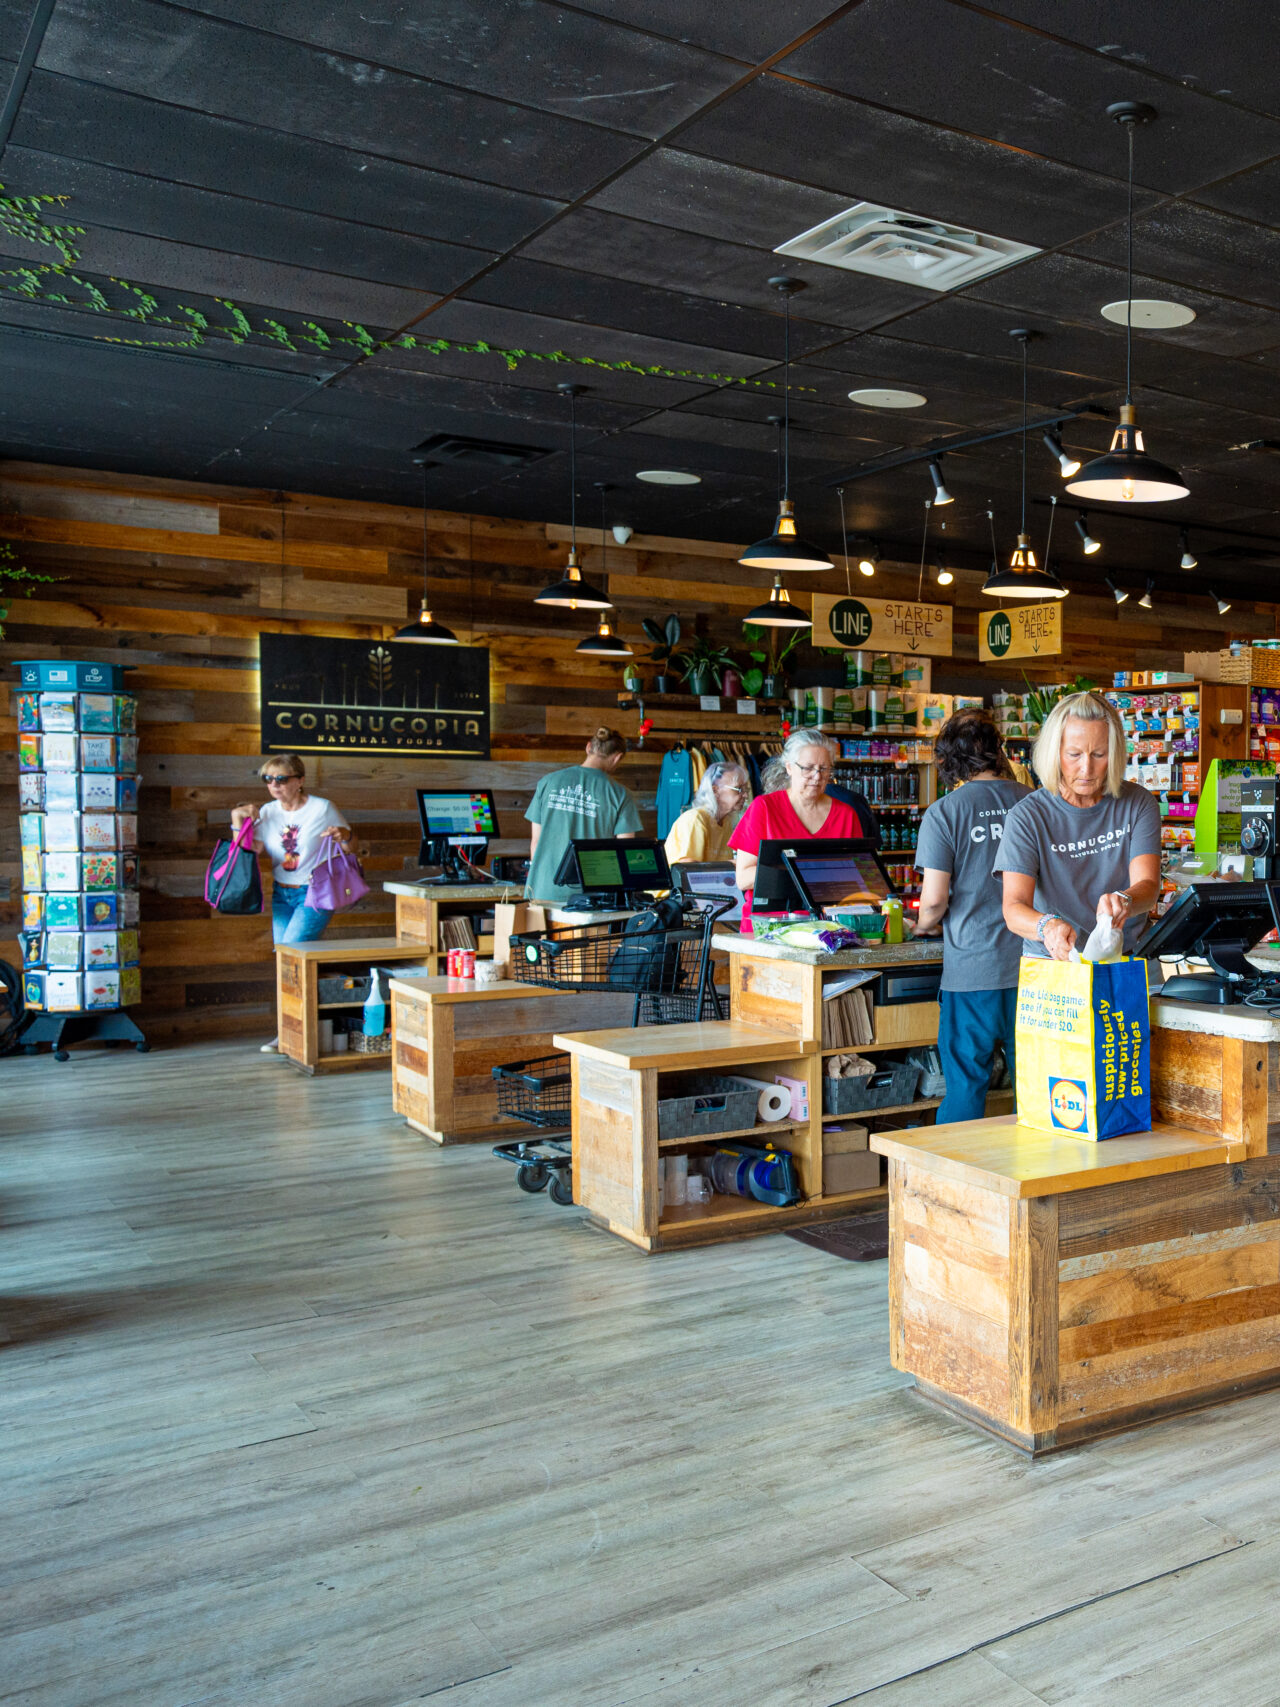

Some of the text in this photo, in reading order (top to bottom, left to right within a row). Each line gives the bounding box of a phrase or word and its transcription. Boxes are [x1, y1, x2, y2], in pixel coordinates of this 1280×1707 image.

[884, 603, 944, 622] STARTS
[1018, 606, 1056, 624] STARTS
[832, 610, 869, 637] LINE
[894, 619, 935, 638] HERE
[1024, 621, 1050, 639] HERE
[988, 623, 1010, 647] LINE
[275, 712, 480, 736] CORNUCOPIA
[317, 734, 443, 746] NATURAL FOODS
[1021, 988, 1035, 999] the
[1037, 989, 1048, 1000] Lid
[1061, 996, 1086, 1006] game:
[1021, 1002, 1079, 1019] see if you can fill
[1020, 1013, 1076, 1032] it for under $20.
[1099, 999, 1117, 1101] suspiciously
[1112, 1010, 1129, 1100] low-priced
[1130, 1020, 1143, 1096] groceries
[1054, 1094, 1083, 1112] LIDL
